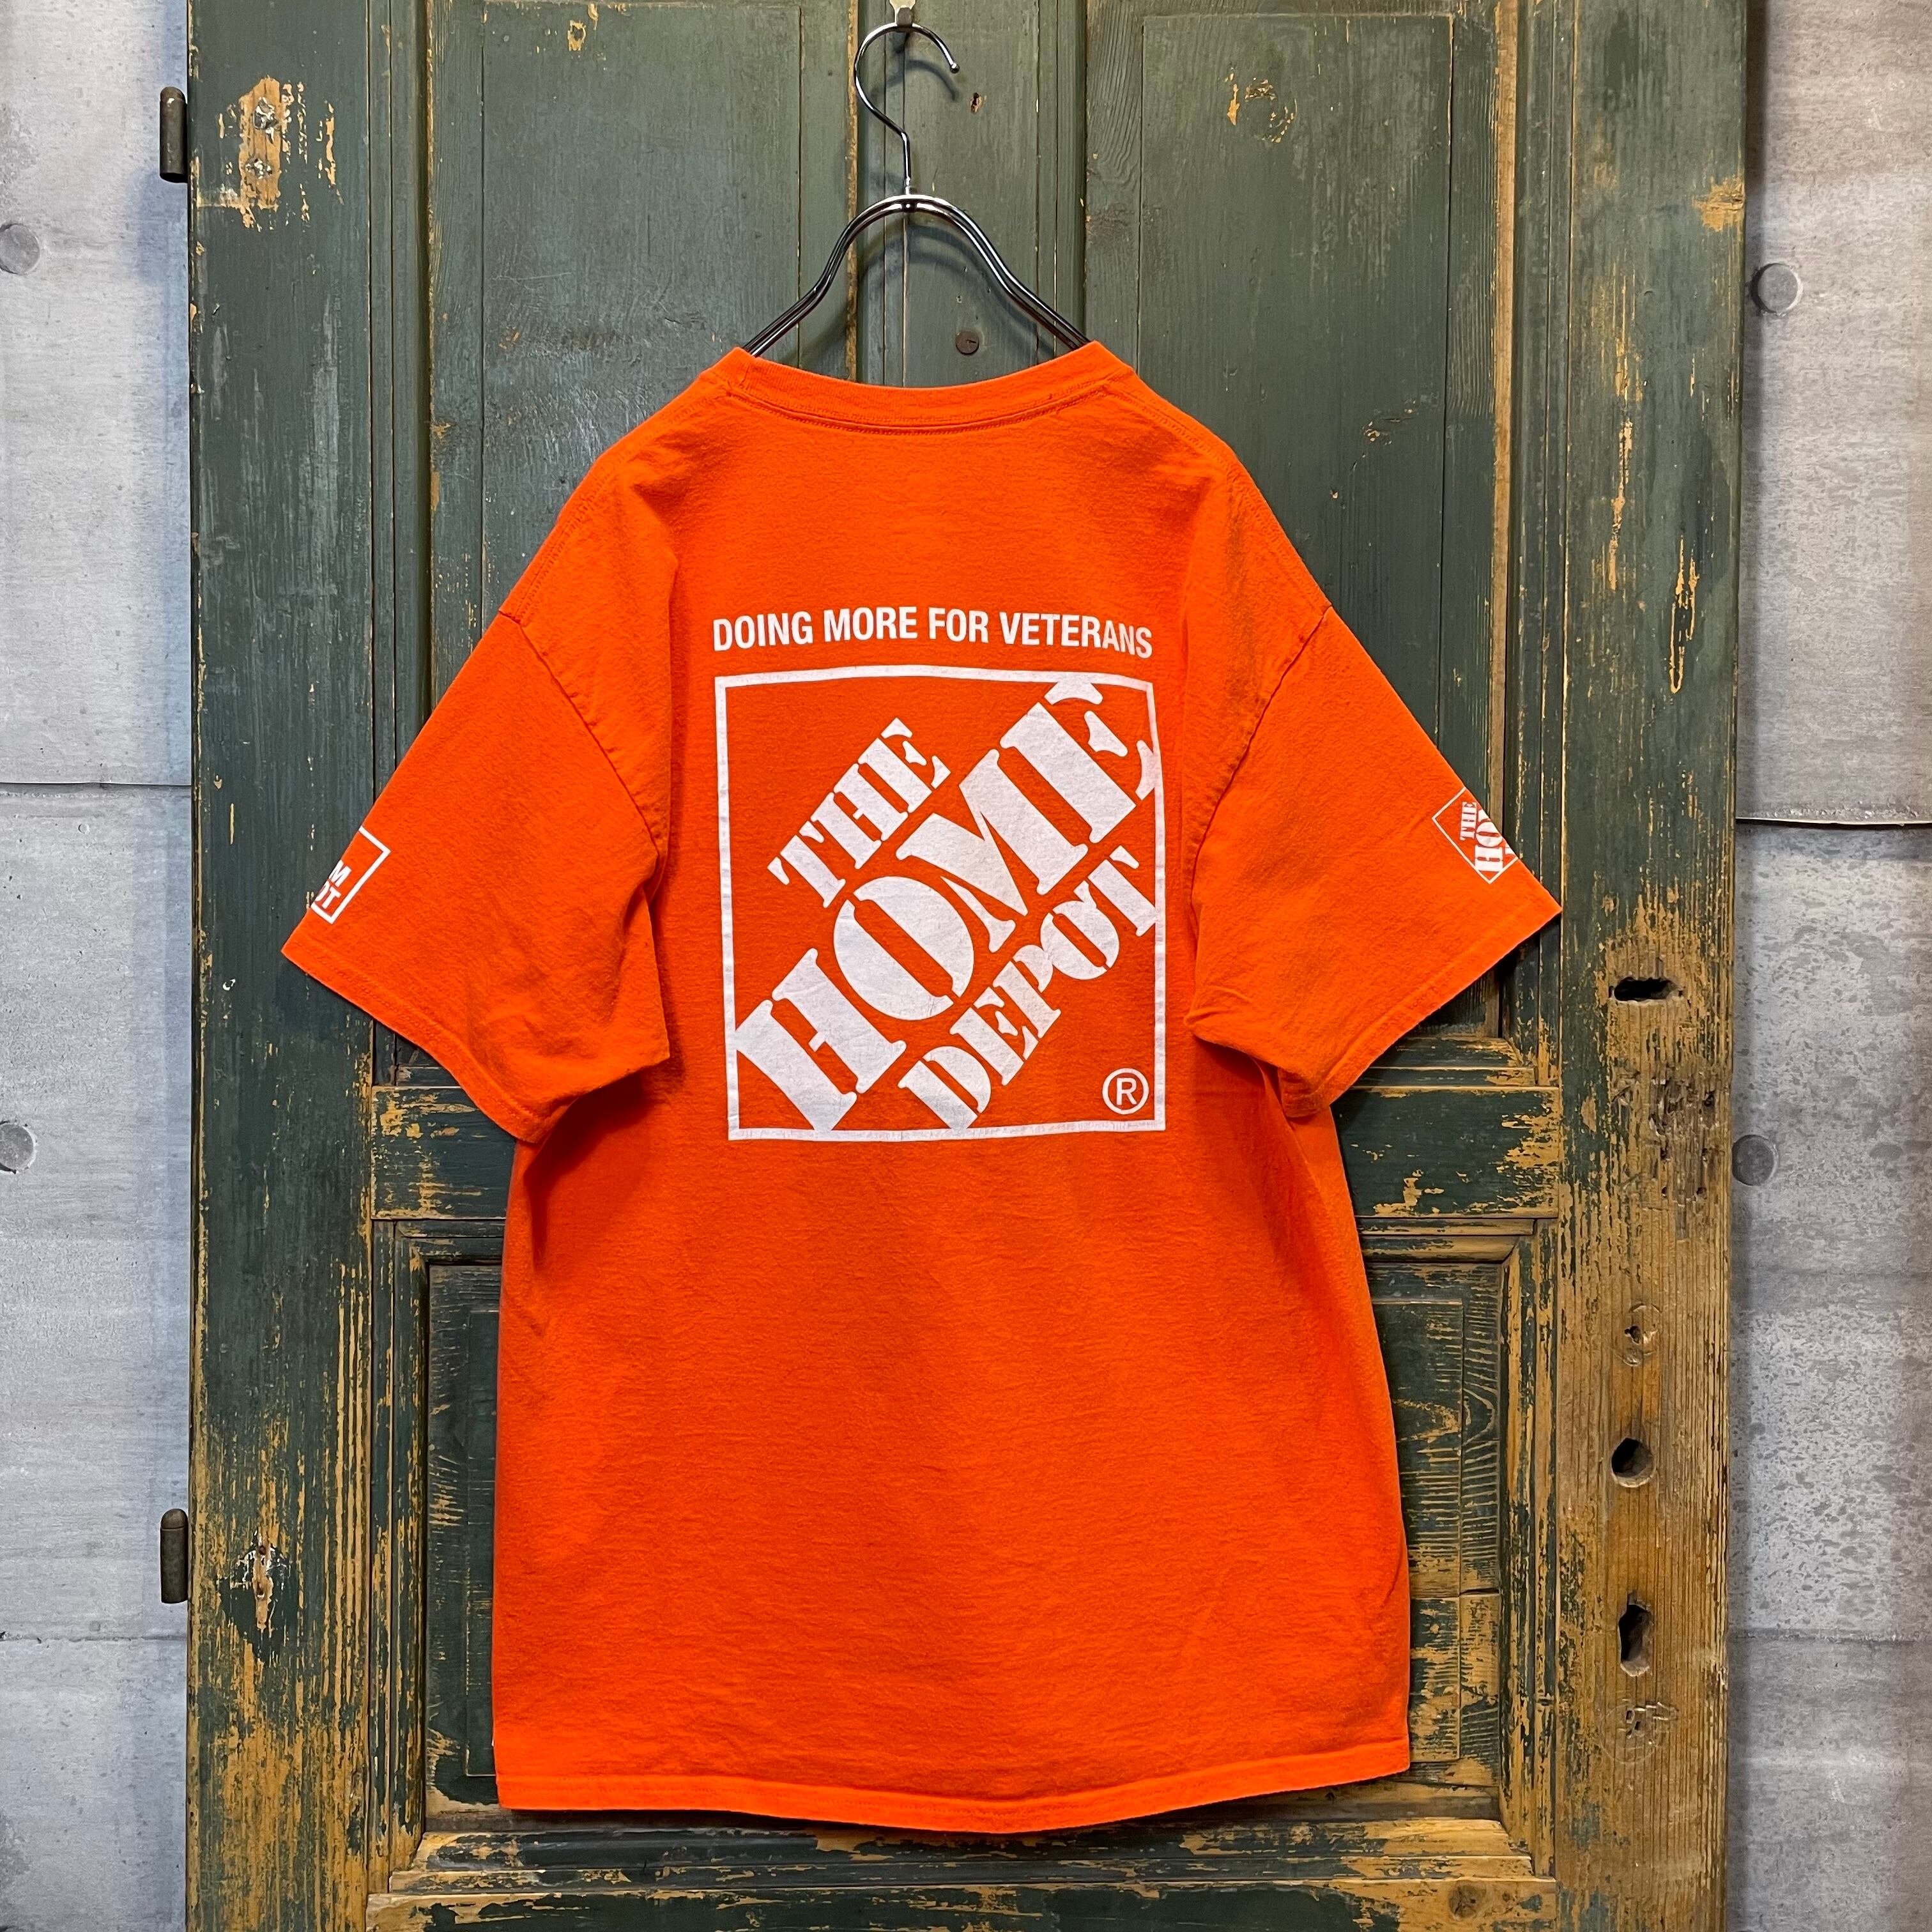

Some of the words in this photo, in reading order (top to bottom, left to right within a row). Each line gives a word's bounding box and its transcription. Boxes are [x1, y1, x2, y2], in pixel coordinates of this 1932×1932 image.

[713, 611, 813, 651] DOING
[824, 606, 917, 642] MORE
[928, 608, 989, 643] FOR
[999, 611, 1153, 659] VETERANS
[735, 679, 1158, 1131] HOME
[767, 717, 951, 908] THE
[1460, 801, 1477, 841] THE
[897, 845, 1157, 1130] DEPOT
